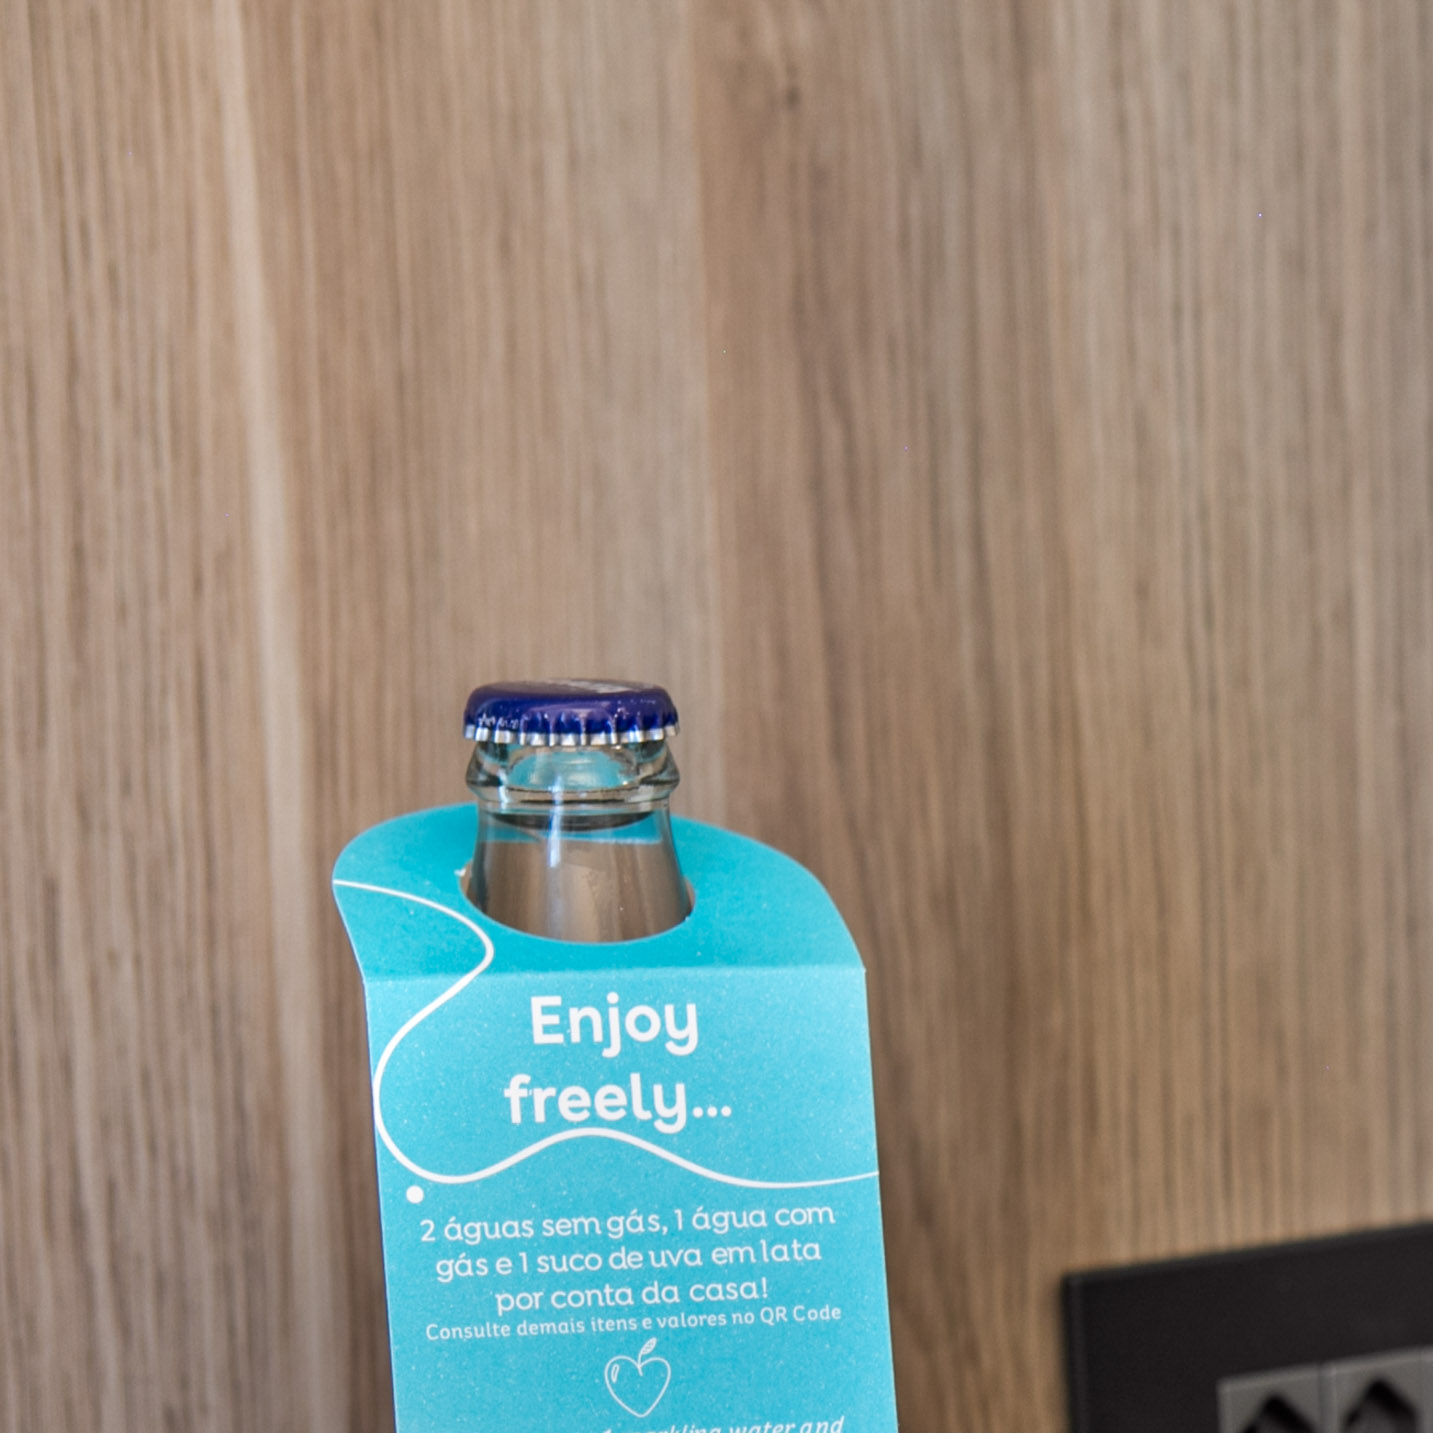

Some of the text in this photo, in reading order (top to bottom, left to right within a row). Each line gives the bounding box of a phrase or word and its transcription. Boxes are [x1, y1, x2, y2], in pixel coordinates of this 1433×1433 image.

[531, 992, 698, 1058] Enjoy
[504, 1073, 731, 1134] freely...
[420, 1206, 835, 1245] 2 águas sem gás, 1 água com
[436, 1239, 822, 1283] gás e 1 suco de uva em lata
[495, 1277, 768, 1316] por conta da casa!
[426, 1304, 841, 1341] Consulte demais itens e valores no QR Code
